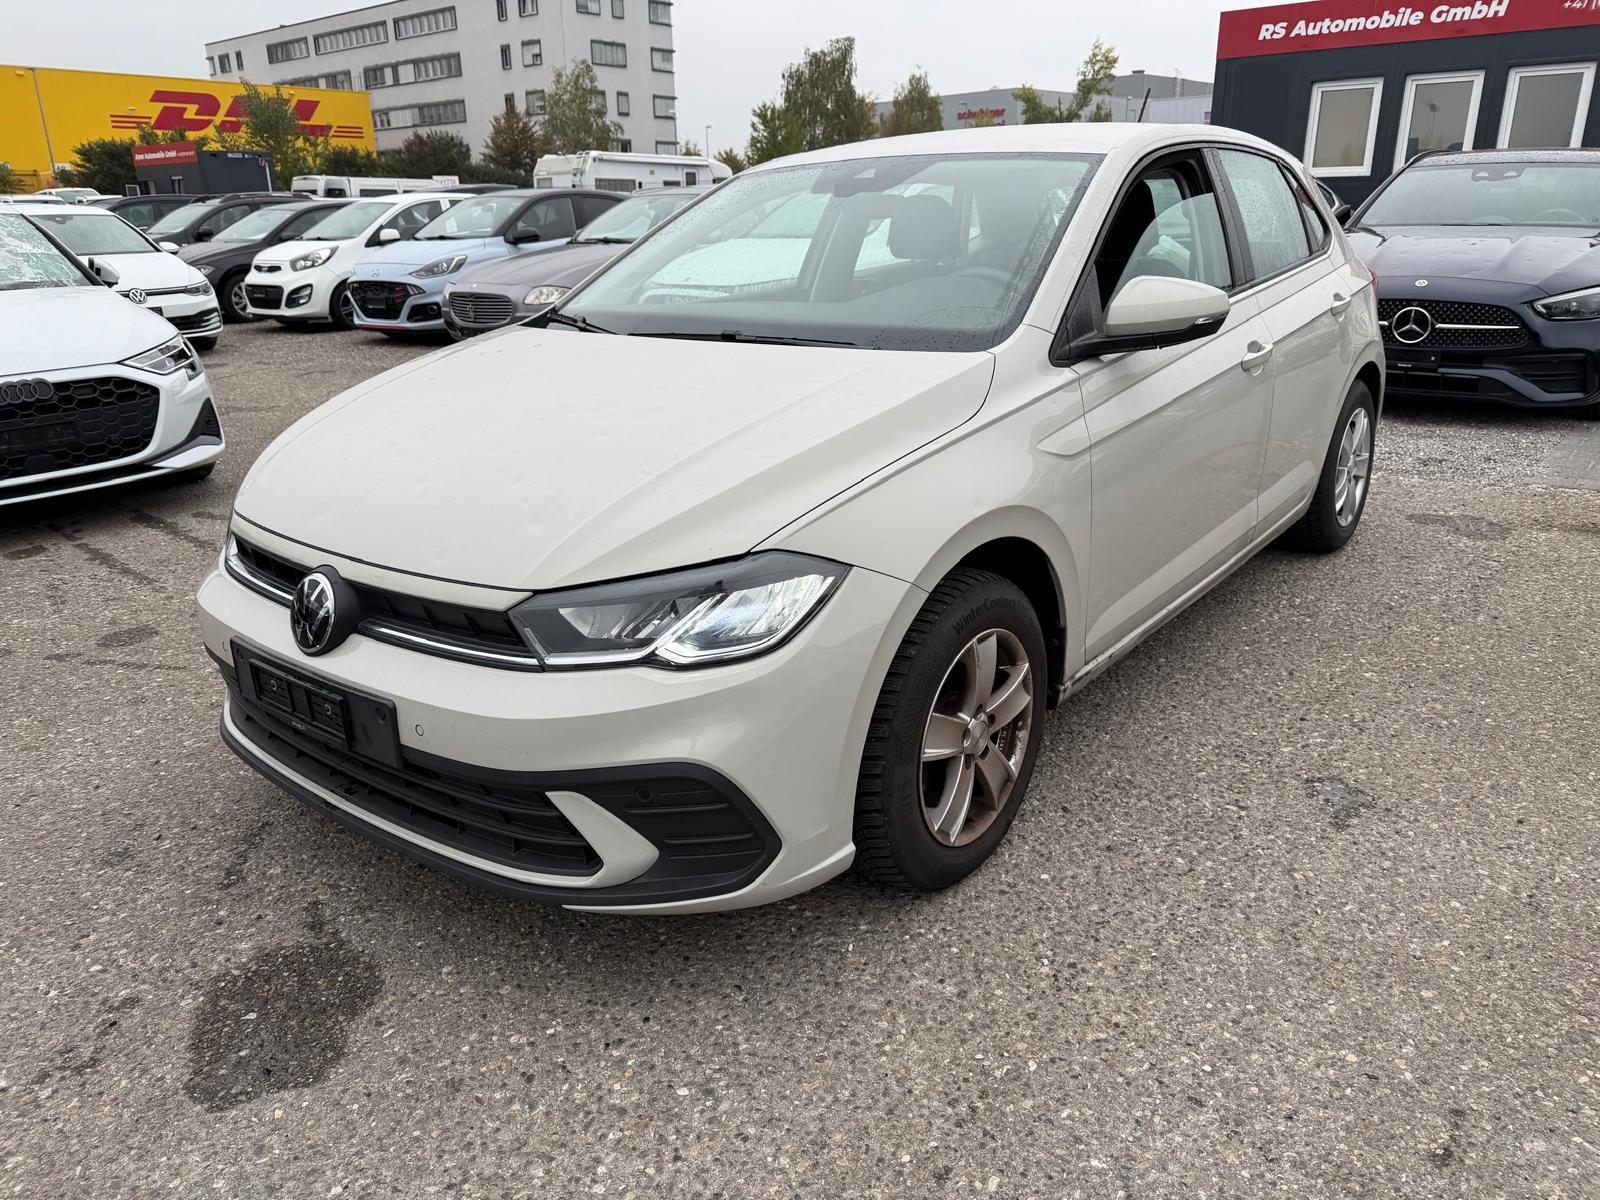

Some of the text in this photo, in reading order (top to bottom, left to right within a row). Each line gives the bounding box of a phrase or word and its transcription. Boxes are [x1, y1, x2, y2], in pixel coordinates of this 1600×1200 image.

[1258, 0, 1510, 41] RS Automobile GmbH
